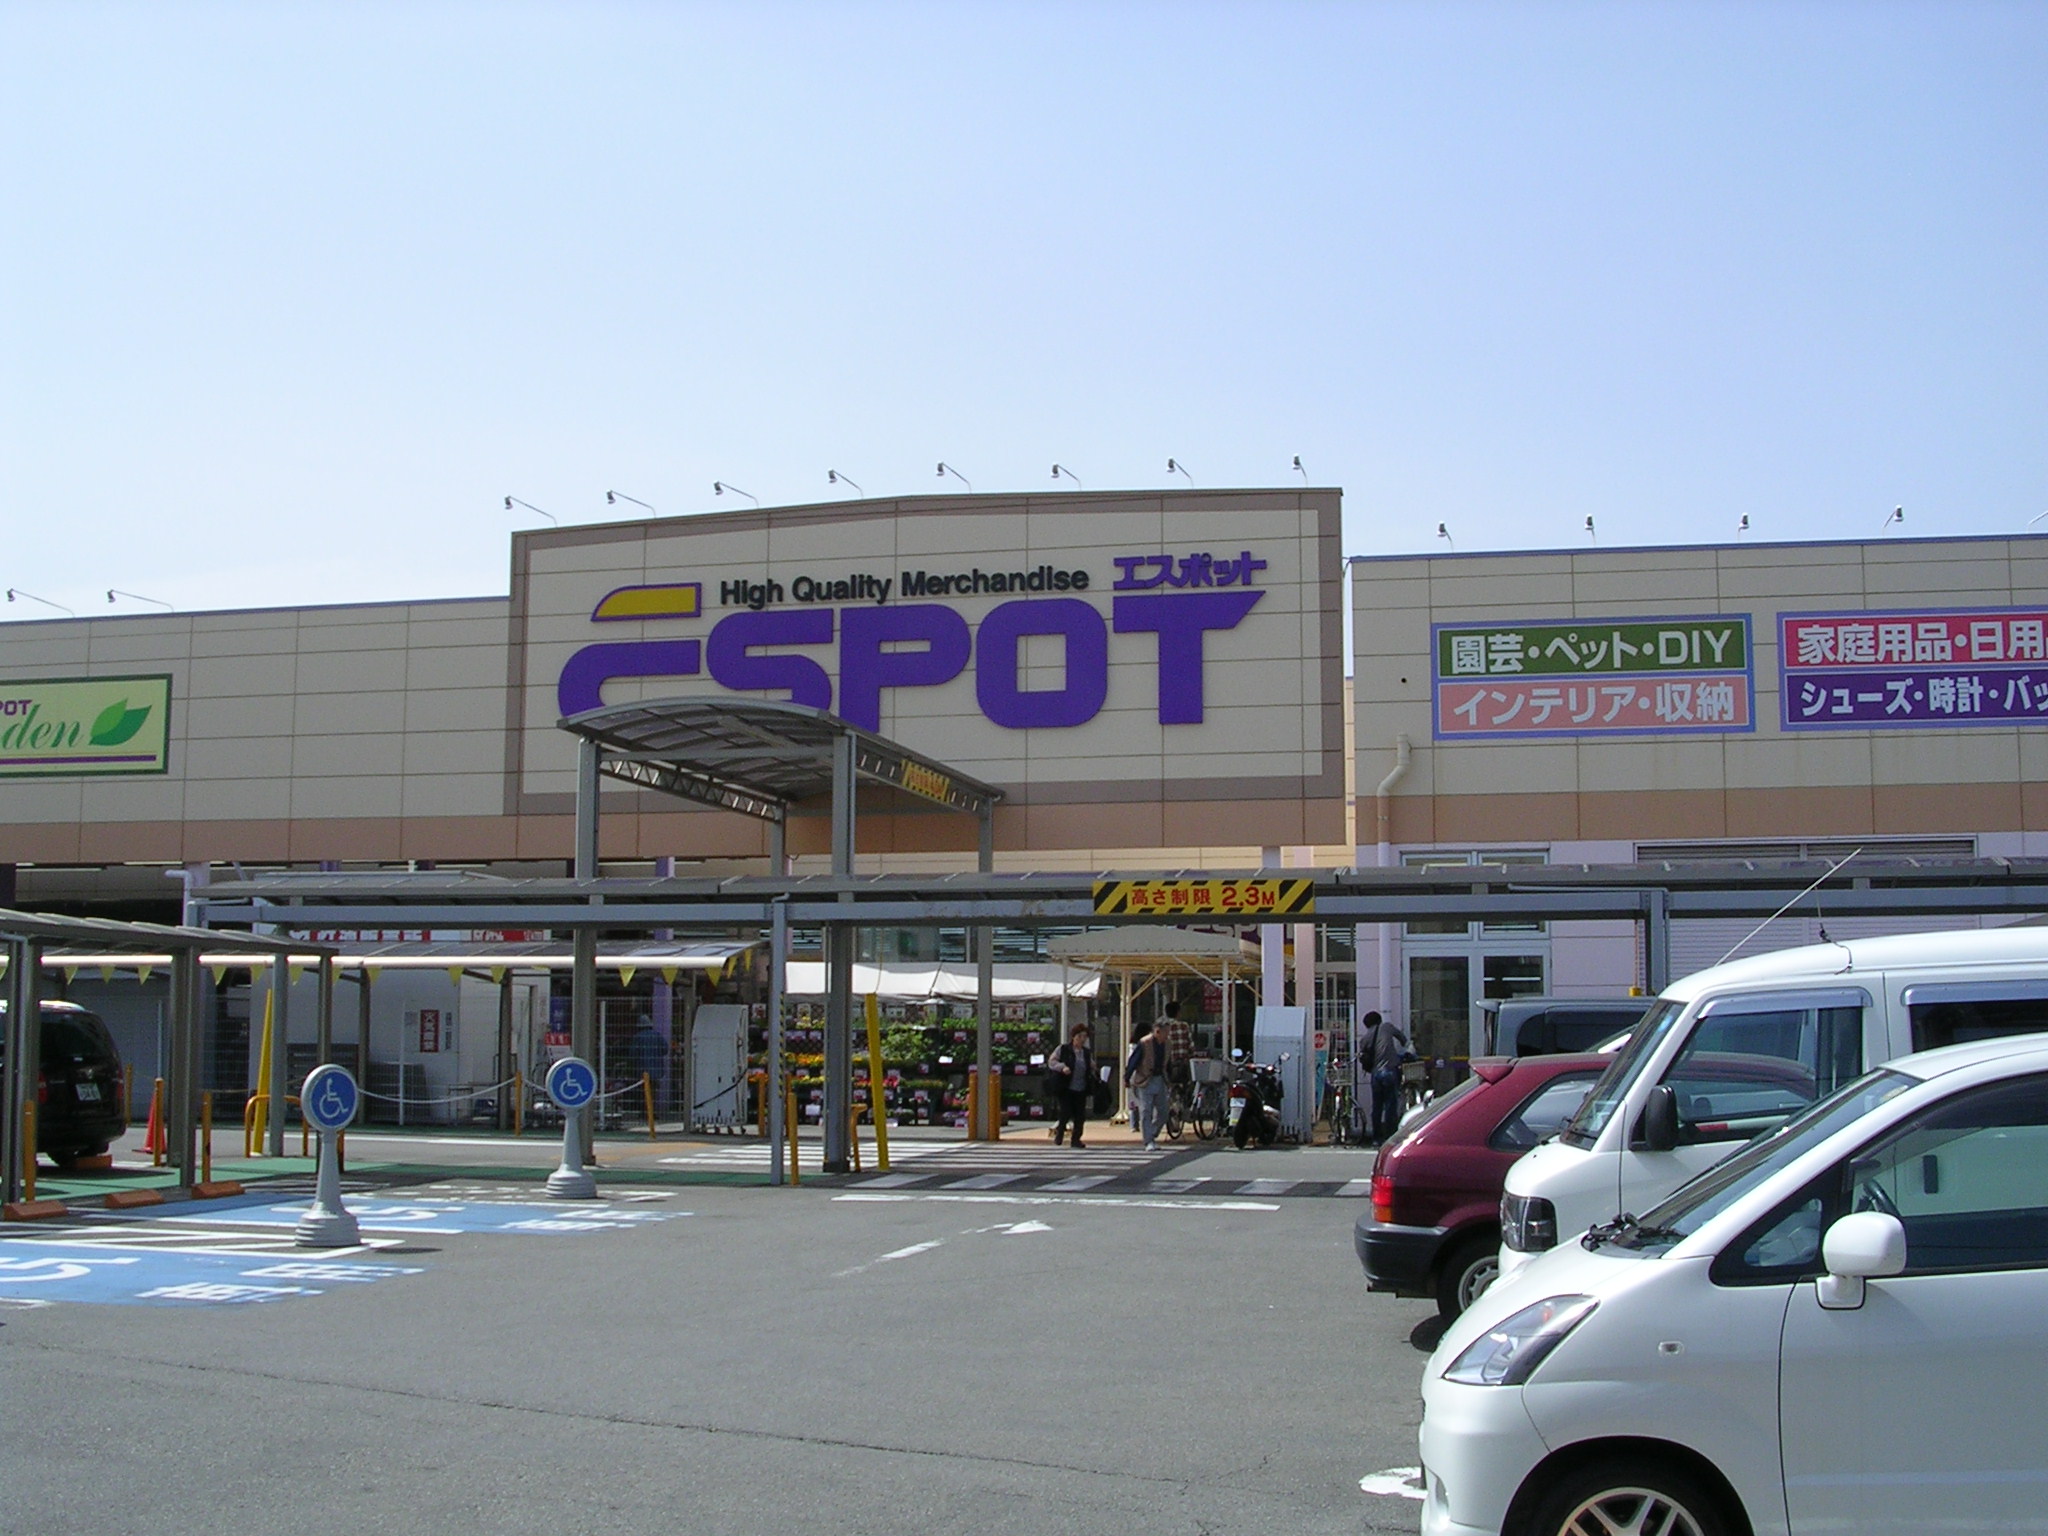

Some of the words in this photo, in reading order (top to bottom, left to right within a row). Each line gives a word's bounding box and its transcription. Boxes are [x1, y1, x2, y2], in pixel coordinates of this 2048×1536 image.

[720, 578, 784, 610] High
[791, 573, 892, 604] Quality
[901, 564, 1089, 598] Merchandise
[1112, 551, 1267, 591] エスポット
[557, 581, 1268, 733] ESPOT
[1450, 629, 1732, 675] 園芸・ペット・DIY
[1797, 619, 2048, 665] 家庭用品・日用
[0, 699, 34, 717] OT
[1453, 680, 1735, 726] インテリア・収納
[1131, 888, 1211, 907] 高さ制限
[1221, 886, 1275, 908] 2.3M
